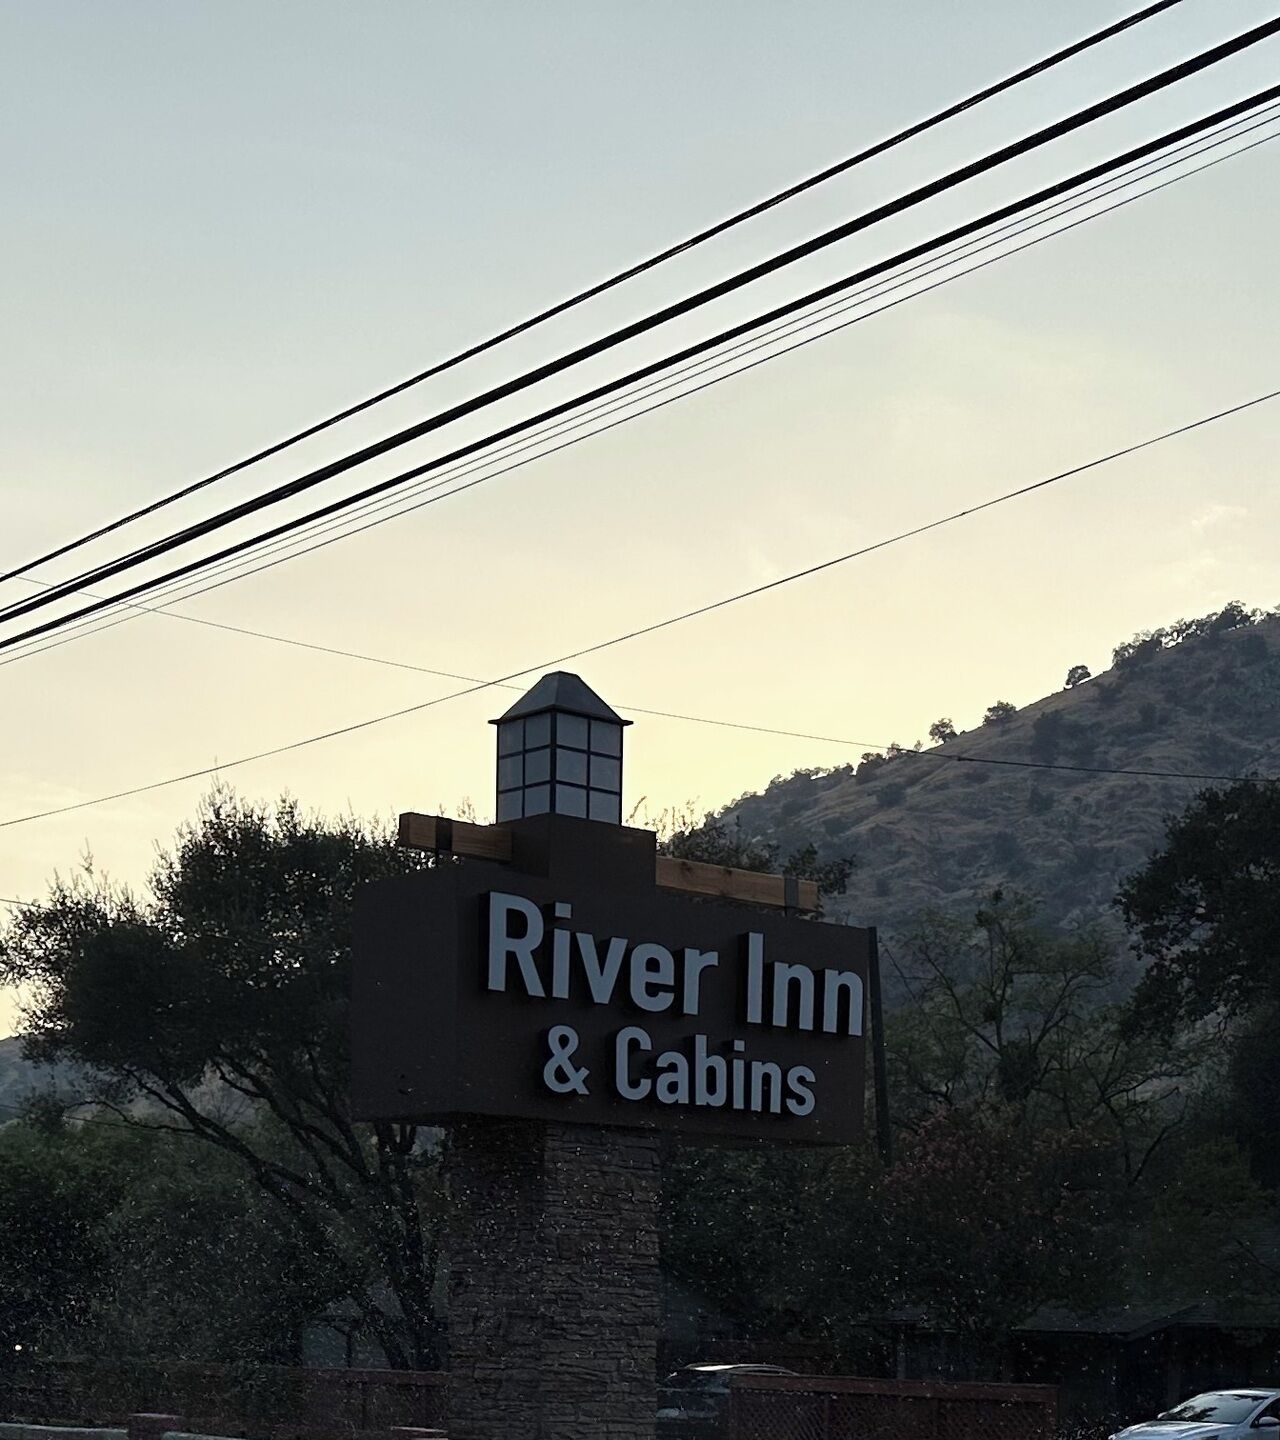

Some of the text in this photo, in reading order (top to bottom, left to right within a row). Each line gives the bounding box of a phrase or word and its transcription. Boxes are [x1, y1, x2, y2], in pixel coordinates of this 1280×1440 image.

[487, 890, 865, 1037] River Inn
[542, 1024, 816, 1118] & Cabins
